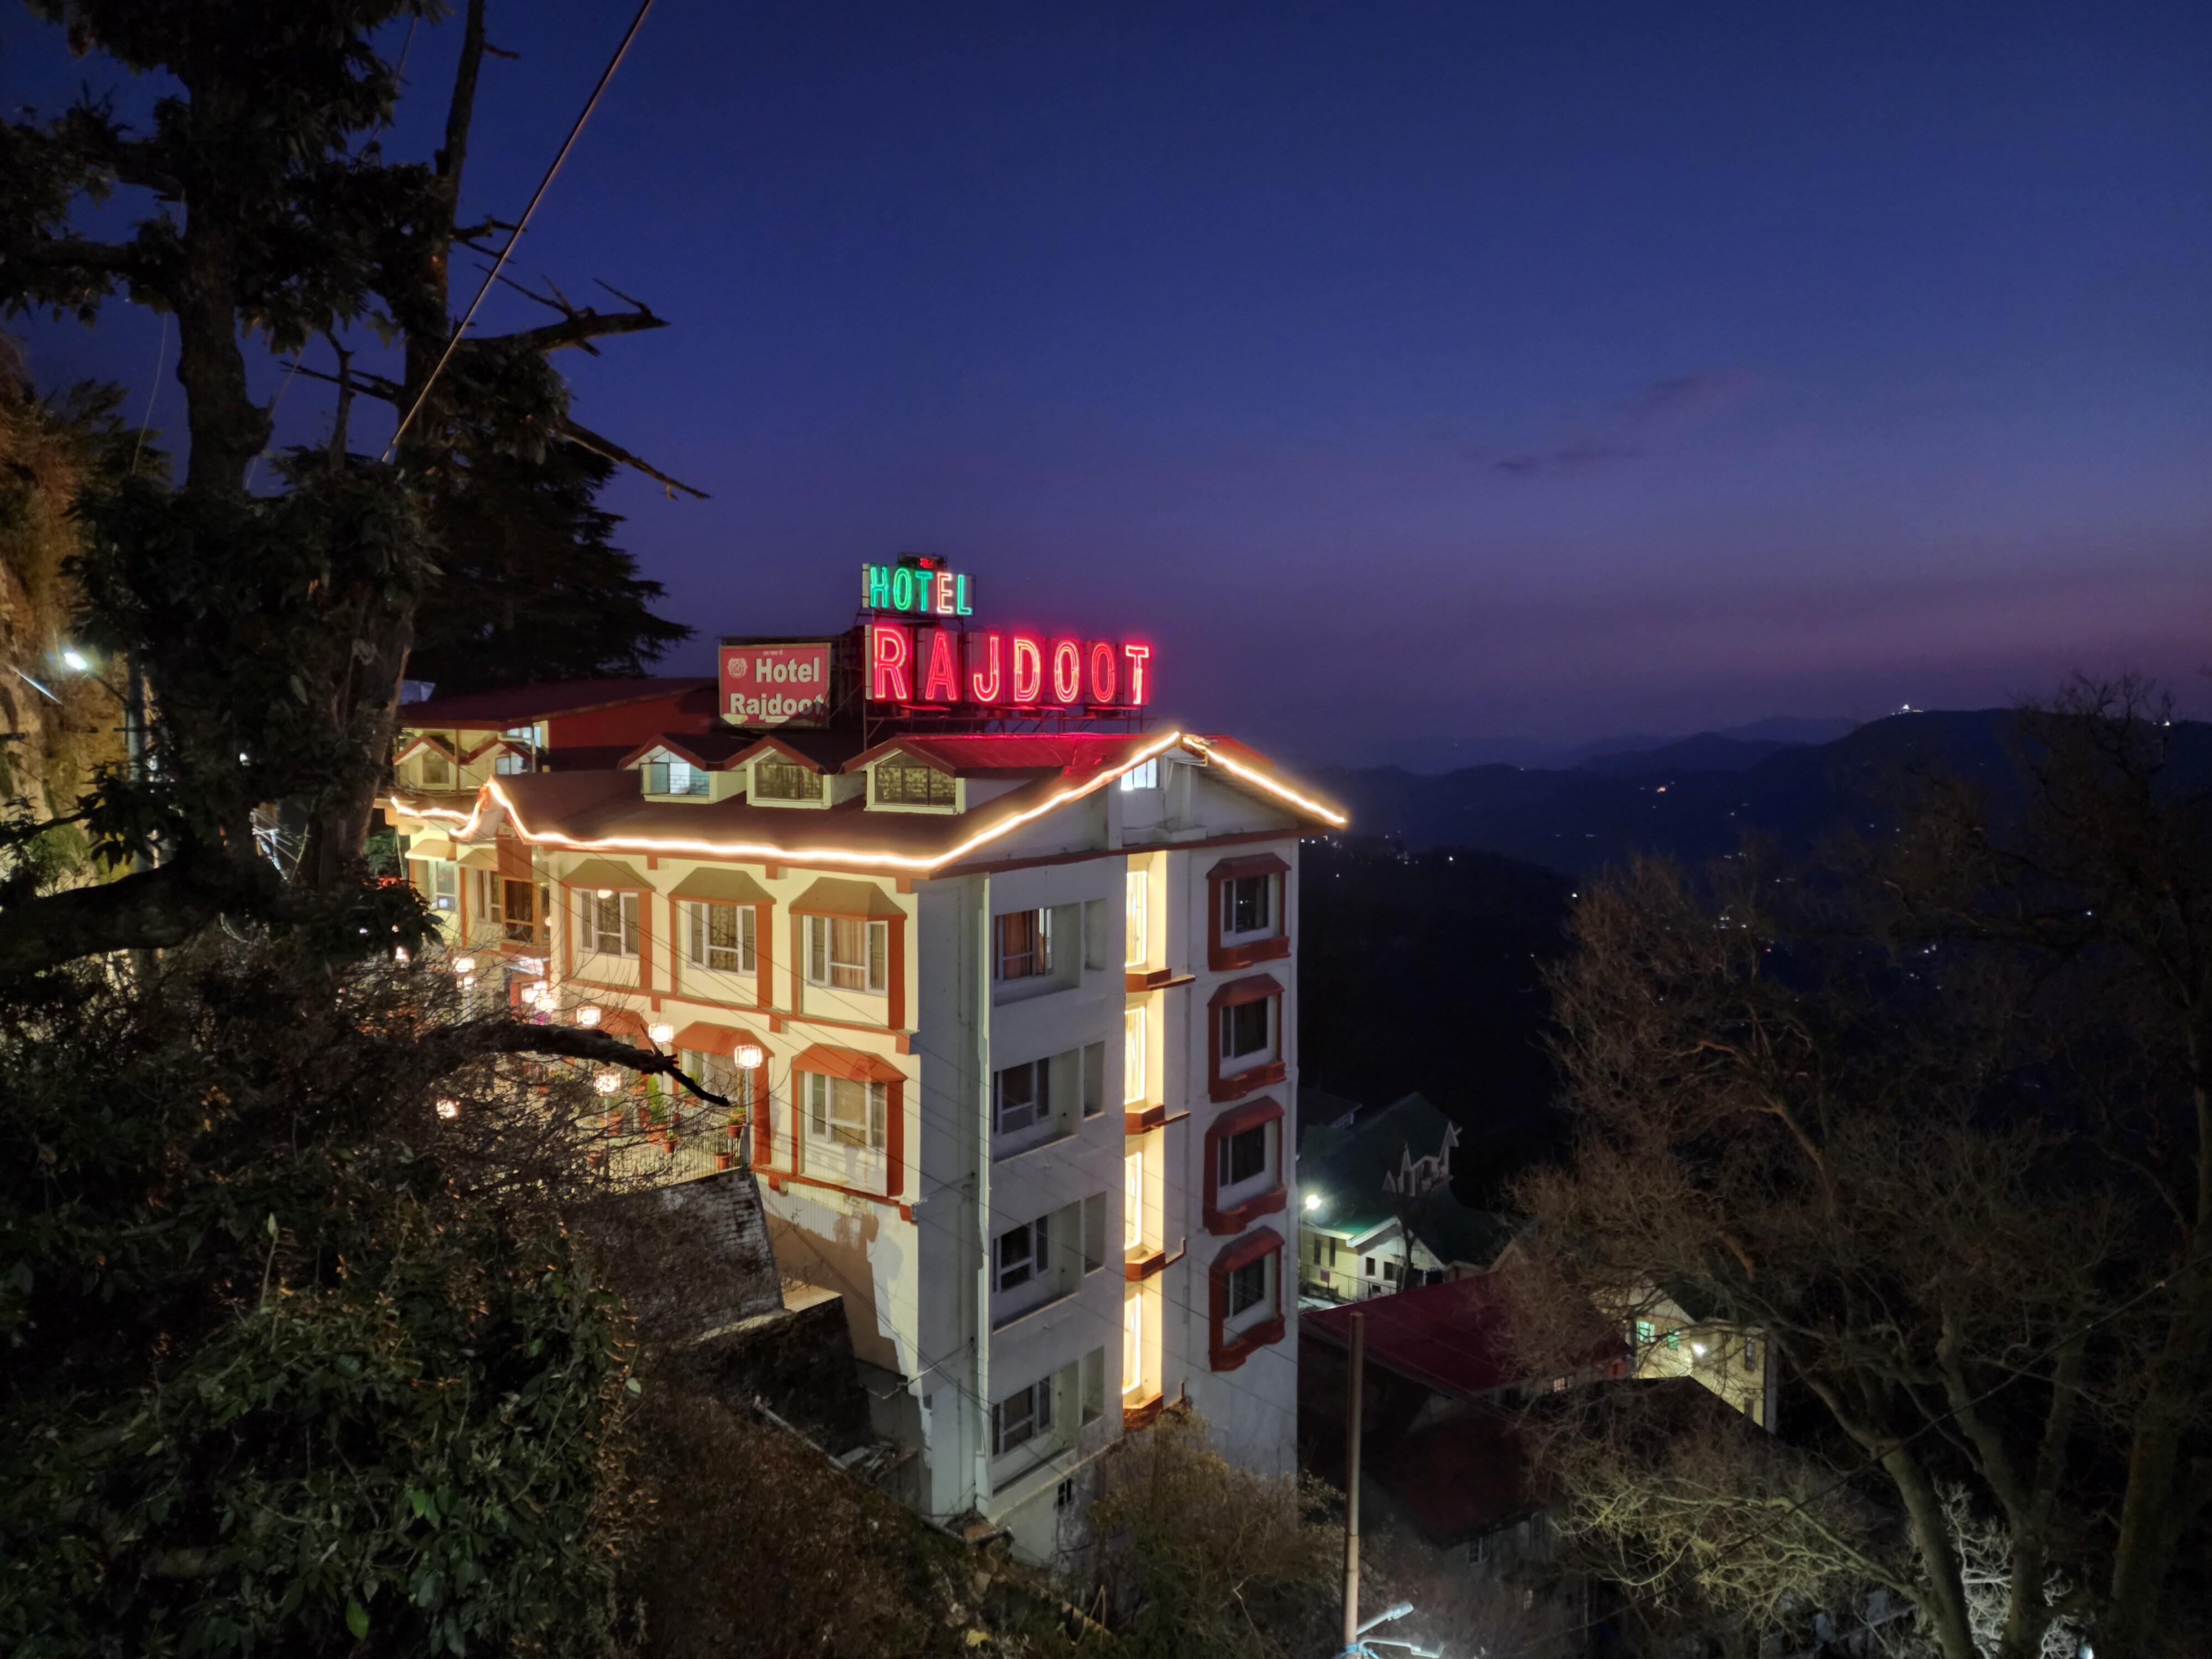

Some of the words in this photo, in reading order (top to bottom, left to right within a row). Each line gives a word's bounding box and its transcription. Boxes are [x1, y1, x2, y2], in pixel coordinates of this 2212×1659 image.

[870, 566, 973, 615] HOTEL
[755, 657, 820, 683] Hotel
[874, 627, 1150, 705] RAJDOOT
[729, 693, 825, 720] Rajdoot
